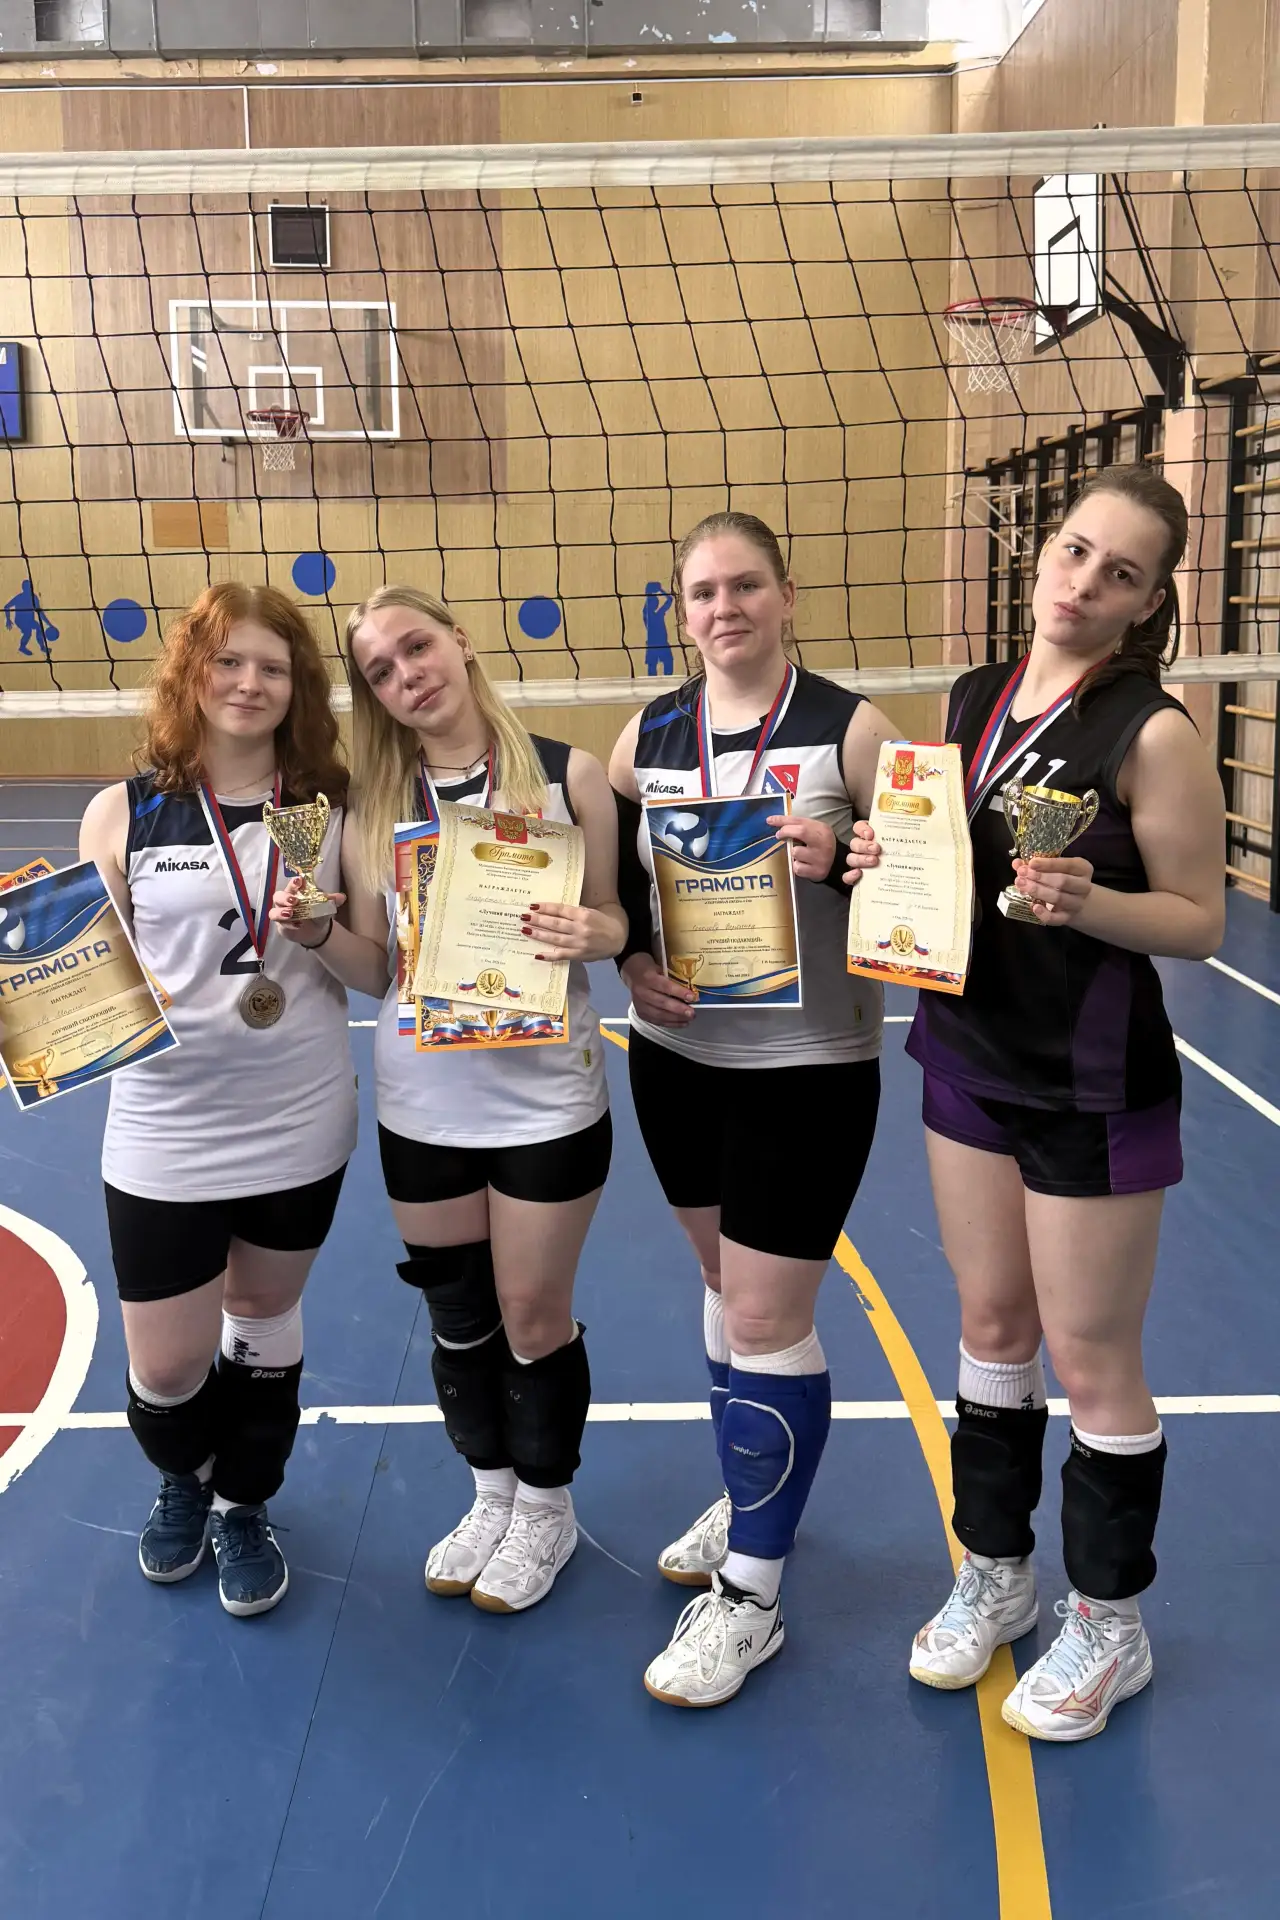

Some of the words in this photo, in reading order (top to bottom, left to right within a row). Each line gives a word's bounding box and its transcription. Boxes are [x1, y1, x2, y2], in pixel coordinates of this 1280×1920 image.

[886, 795, 920, 812] Грамота
[489, 846, 535, 863] Грамота
[675, 874, 774, 894] ГРАМОТА
[218, 908, 264, 975] 2
[0, 940, 112, 997] ГРАМОТА
[972, 1407, 999, 1419] asics
